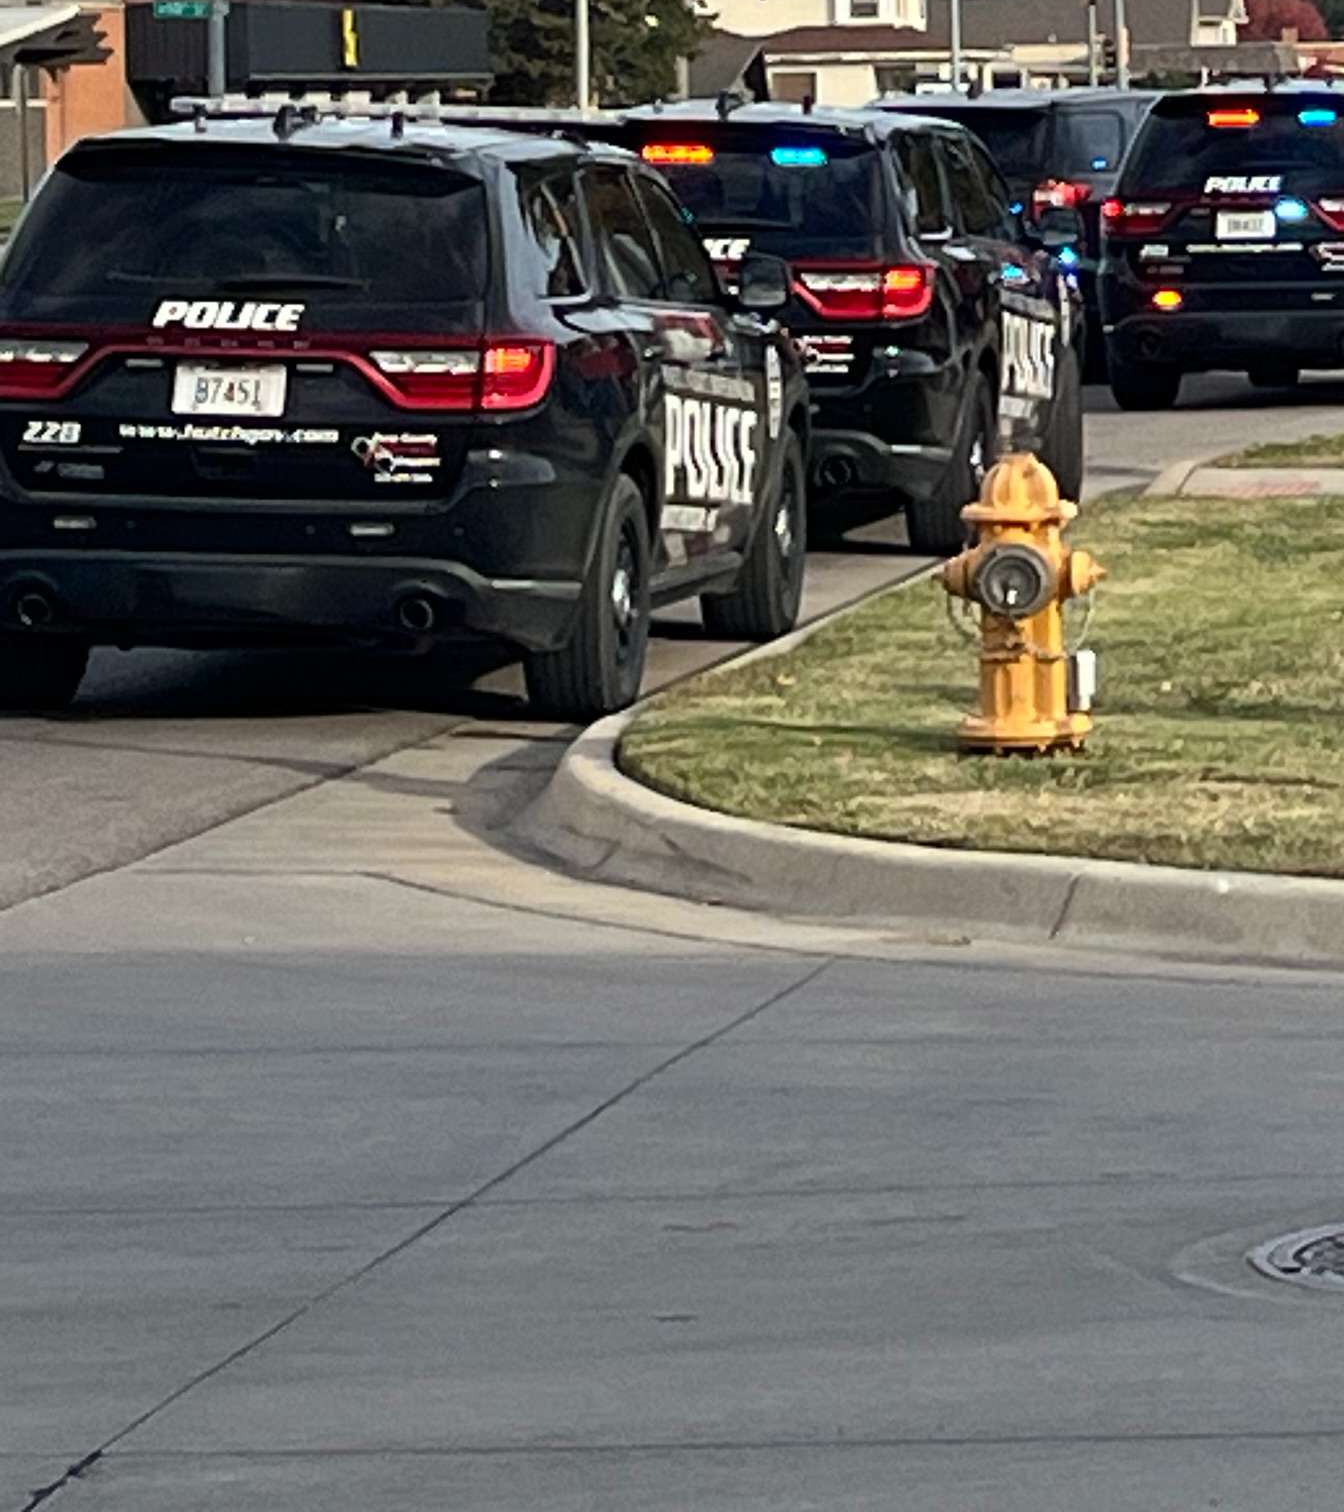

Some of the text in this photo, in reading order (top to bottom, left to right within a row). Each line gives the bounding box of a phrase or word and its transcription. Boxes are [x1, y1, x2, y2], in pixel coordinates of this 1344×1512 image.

[1204, 176, 1282, 193] POLICE
[153, 300, 304, 331] POLICE
[1001, 310, 1056, 400] POLICE
[664, 393, 758, 505] POLICE
